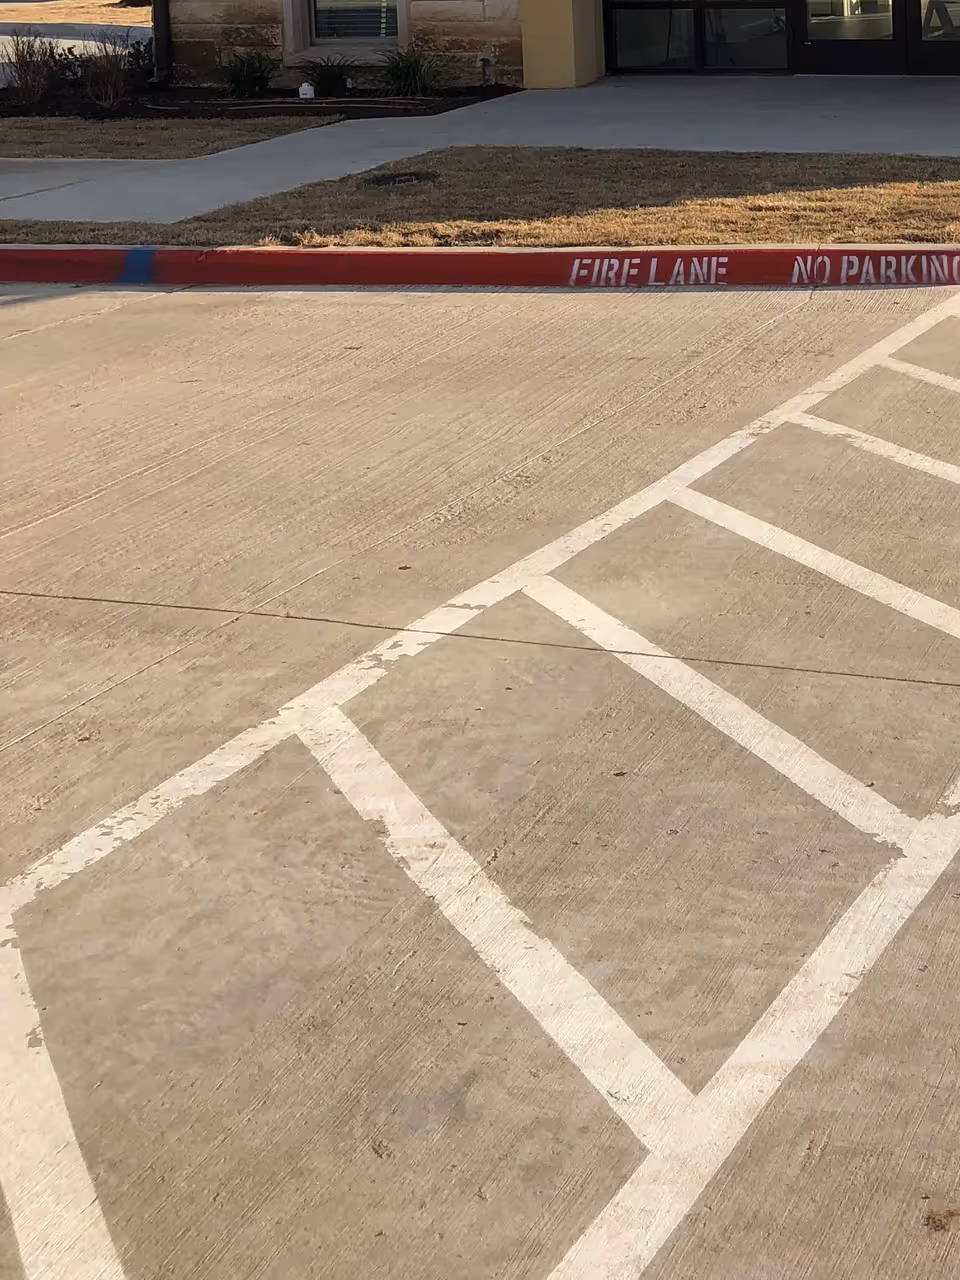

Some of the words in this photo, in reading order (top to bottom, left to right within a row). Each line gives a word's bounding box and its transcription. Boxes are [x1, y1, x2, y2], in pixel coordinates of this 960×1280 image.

[569, 258, 640, 287] FIRE
[647, 257, 728, 285] LANE
[792, 255, 831, 284] NO
